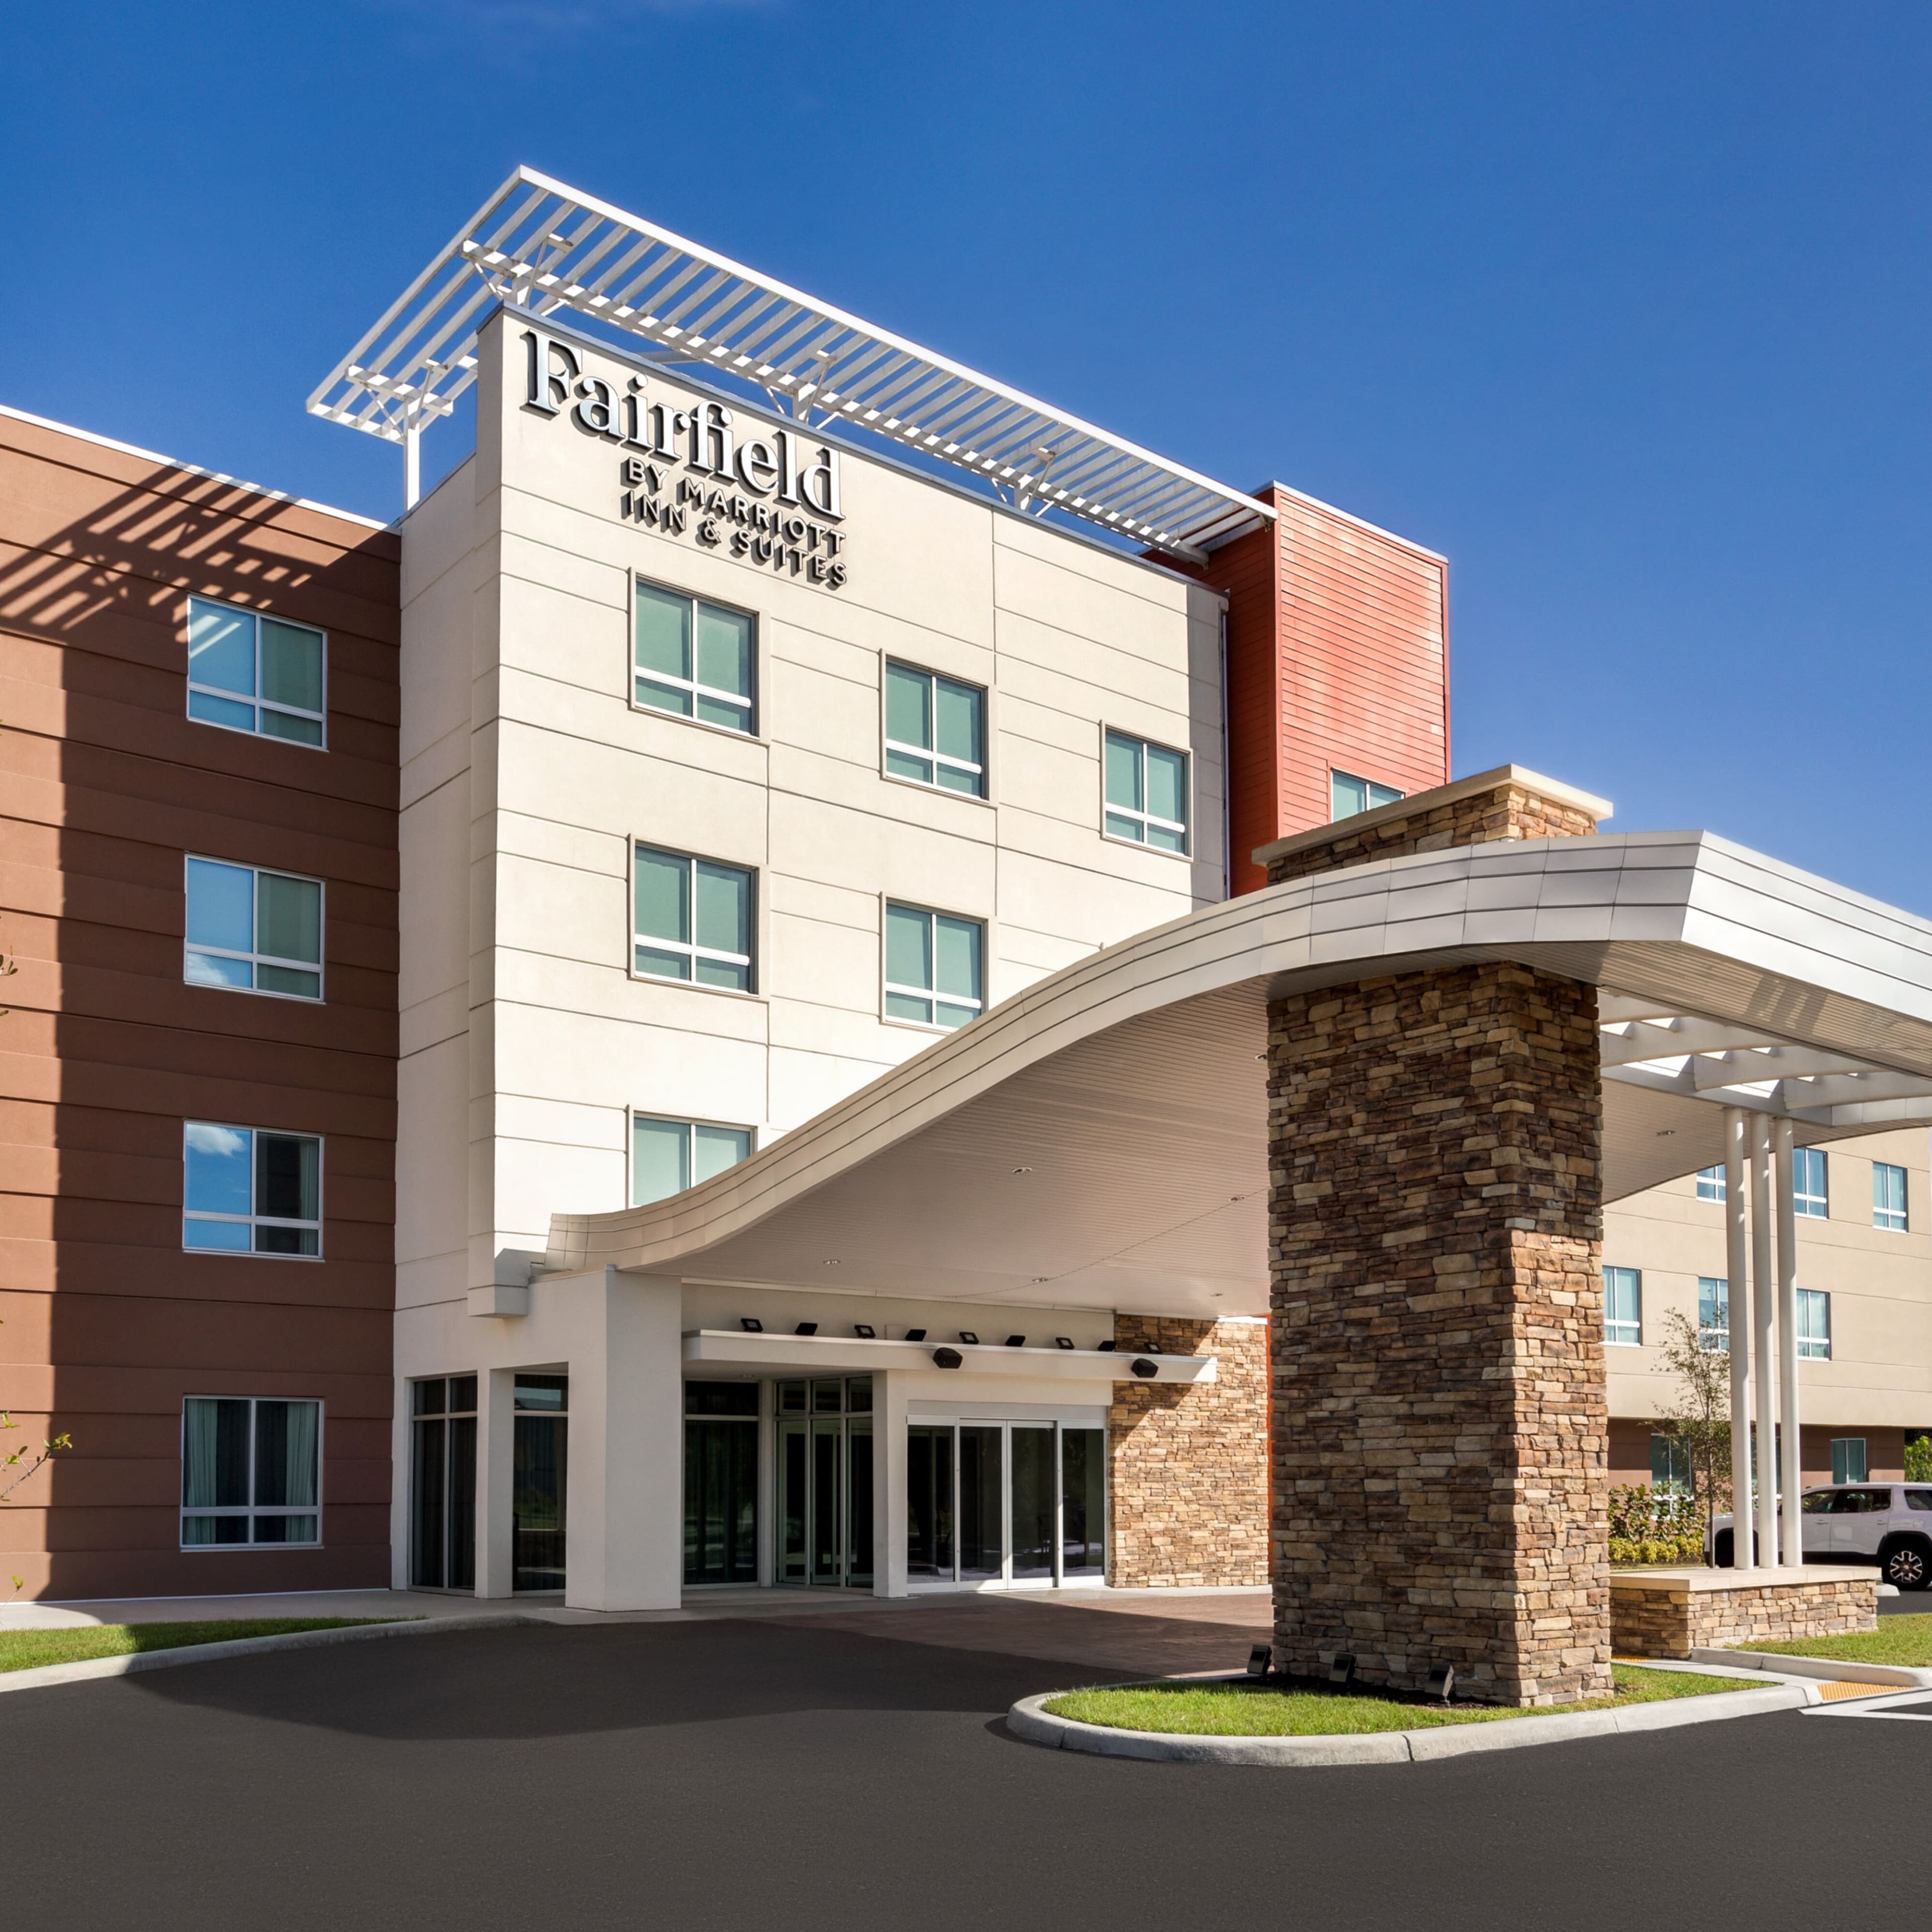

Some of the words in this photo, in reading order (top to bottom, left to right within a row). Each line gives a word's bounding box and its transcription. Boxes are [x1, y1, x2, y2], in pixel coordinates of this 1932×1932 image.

[524, 328, 846, 520] Fairfield
[626, 456, 669, 489] BY
[682, 477, 846, 553] MARRIOTT
[626, 490, 687, 531] INN
[701, 517, 722, 544] &
[735, 529, 847, 587] SUITES
